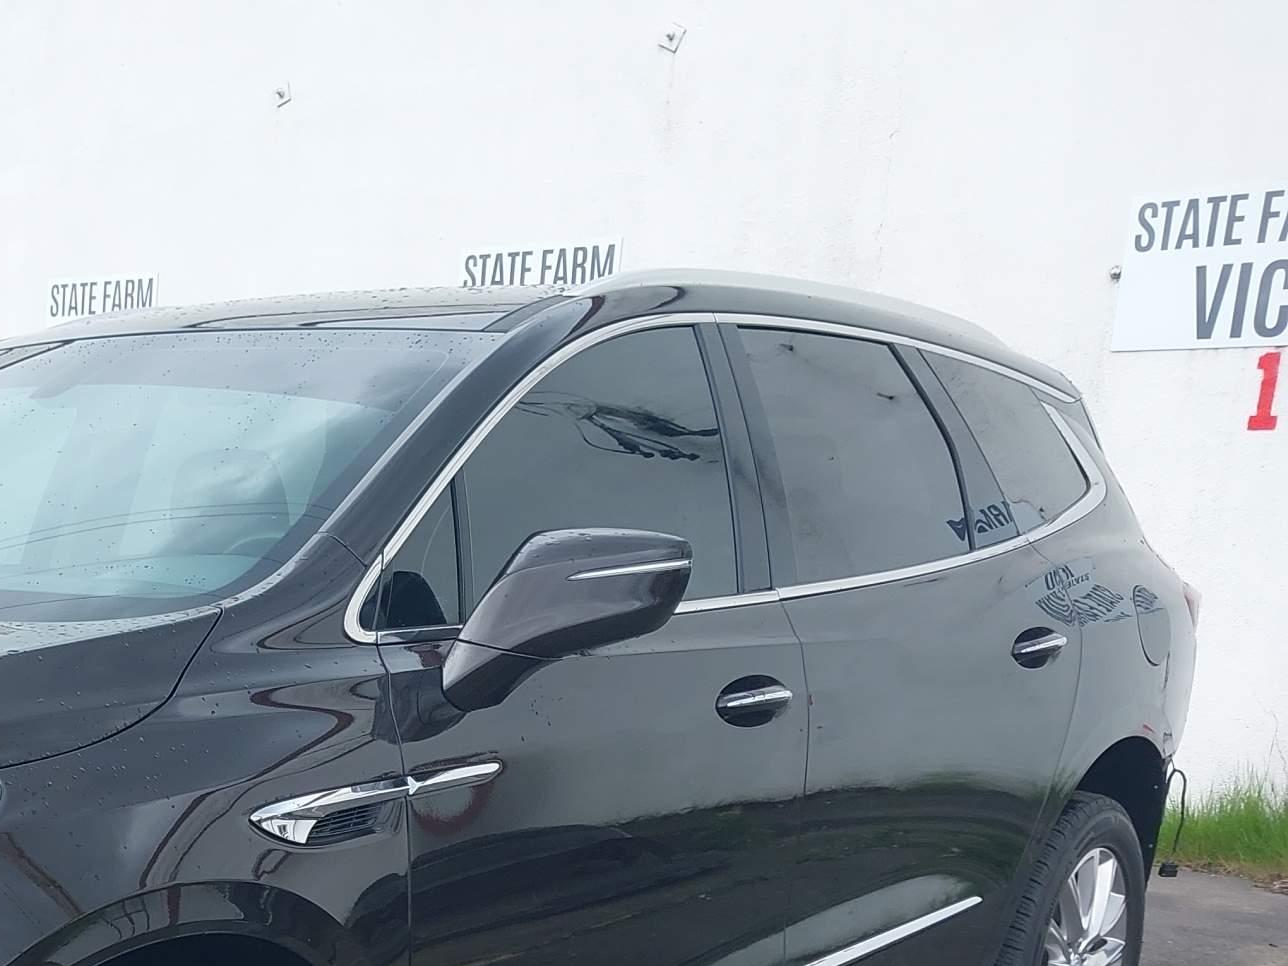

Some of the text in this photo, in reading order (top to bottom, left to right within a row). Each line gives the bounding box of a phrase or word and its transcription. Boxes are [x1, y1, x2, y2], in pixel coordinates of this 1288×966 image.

[1135, 193, 1250, 252] STATE
[462, 243, 616, 287] STATE FARM
[50, 277, 154, 317] STATE FARM
